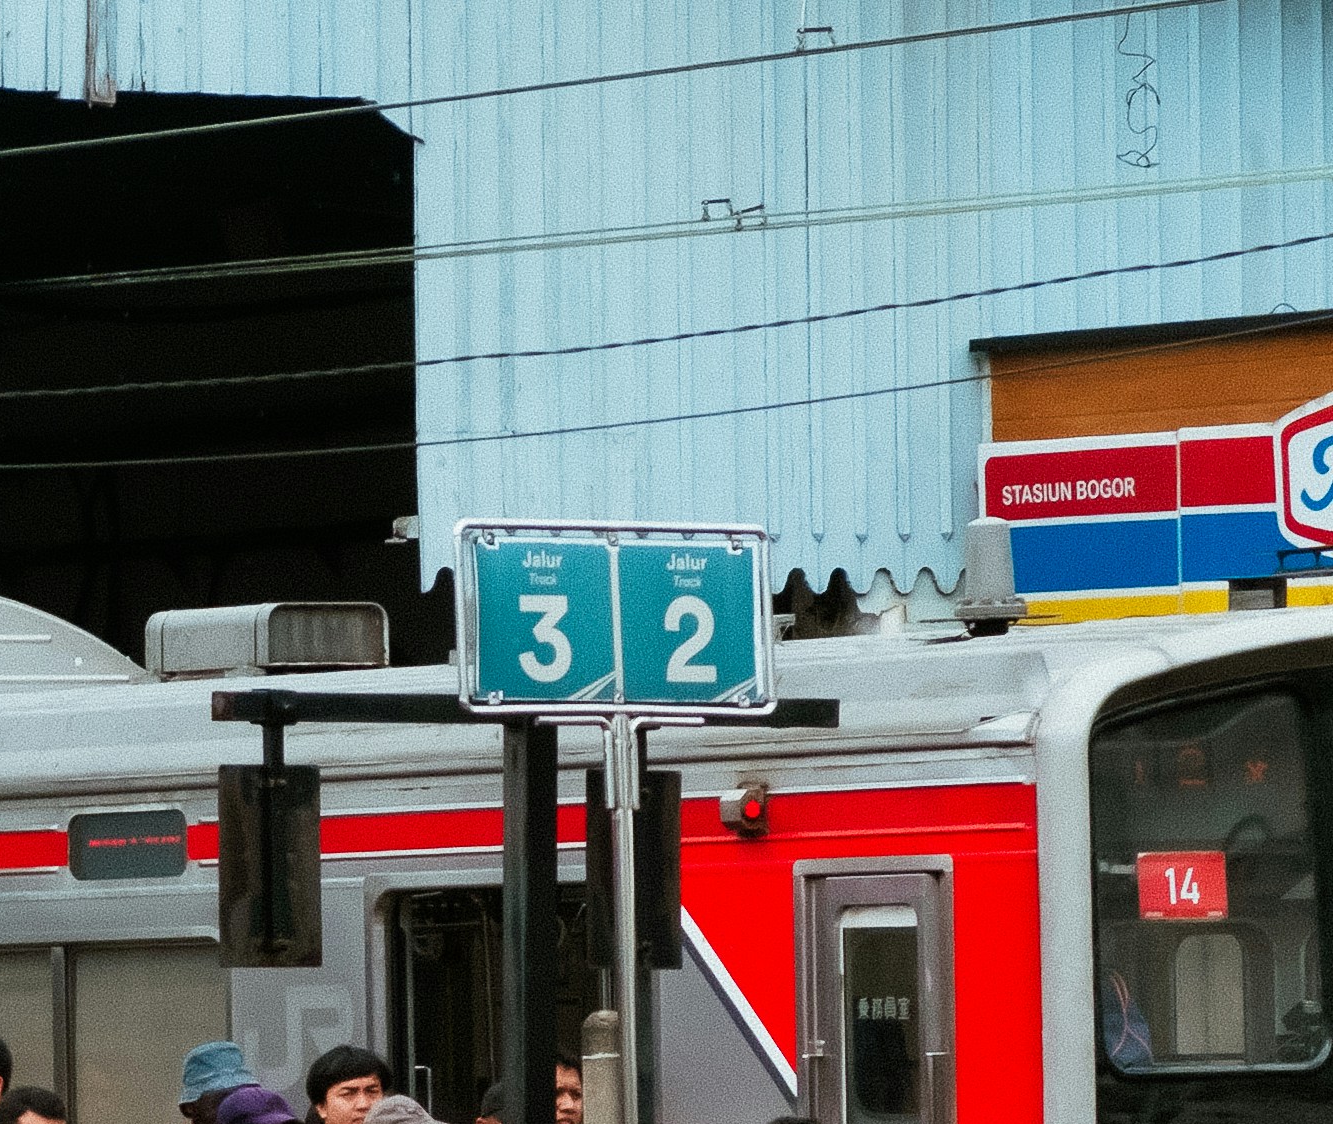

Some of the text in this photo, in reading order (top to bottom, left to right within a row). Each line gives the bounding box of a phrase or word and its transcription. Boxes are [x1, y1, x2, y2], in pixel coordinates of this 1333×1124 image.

[1002, 476, 1136, 506] STASIUN BOGOR
[521, 550, 563, 569] Jalur
[665, 553, 708, 571] Jalur
[518, 594, 573, 683] 3
[664, 595, 718, 683] 2
[1164, 866, 1201, 905] 14
